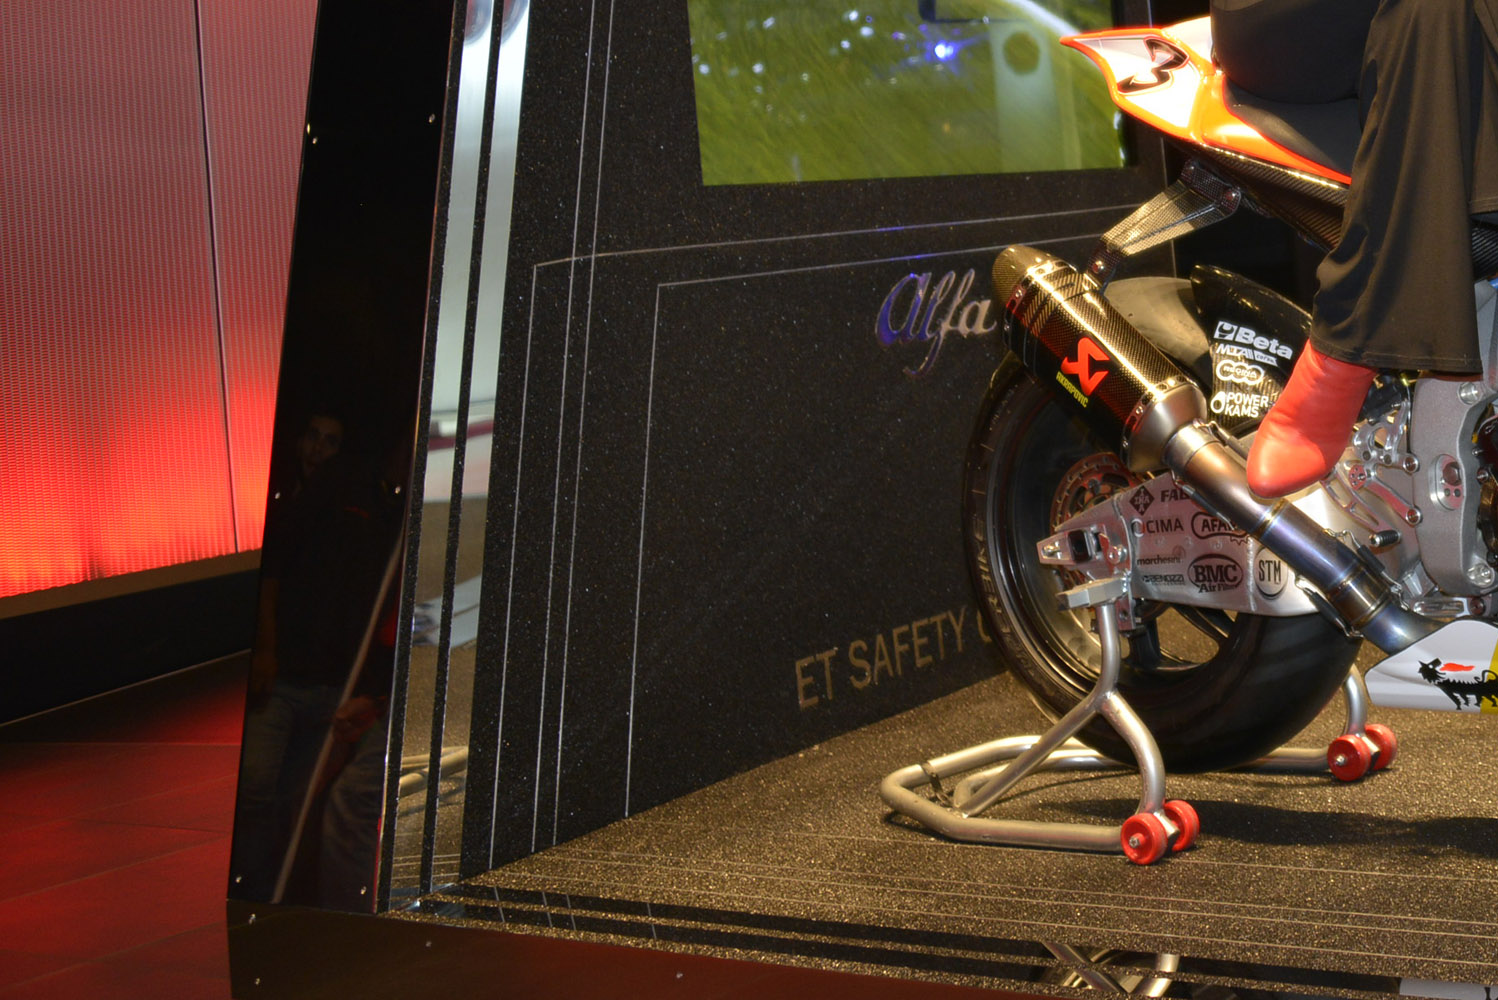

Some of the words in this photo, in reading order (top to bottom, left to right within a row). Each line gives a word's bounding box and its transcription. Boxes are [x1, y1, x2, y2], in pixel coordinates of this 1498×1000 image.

[875, 268, 997, 379] Alfa
[1234, 326, 1294, 360] Beta
[1226, 391, 1269, 408] POWER
[1224, 403, 1259, 418] KAMS
[1146, 518, 1184, 533] CIMA
[1193, 564, 1238, 584] BMC
[1258, 559, 1282, 584] STM
[1199, 584, 1217, 593] Air
[795, 647, 838, 709] ET
[848, 606, 967, 690] SAFETY
